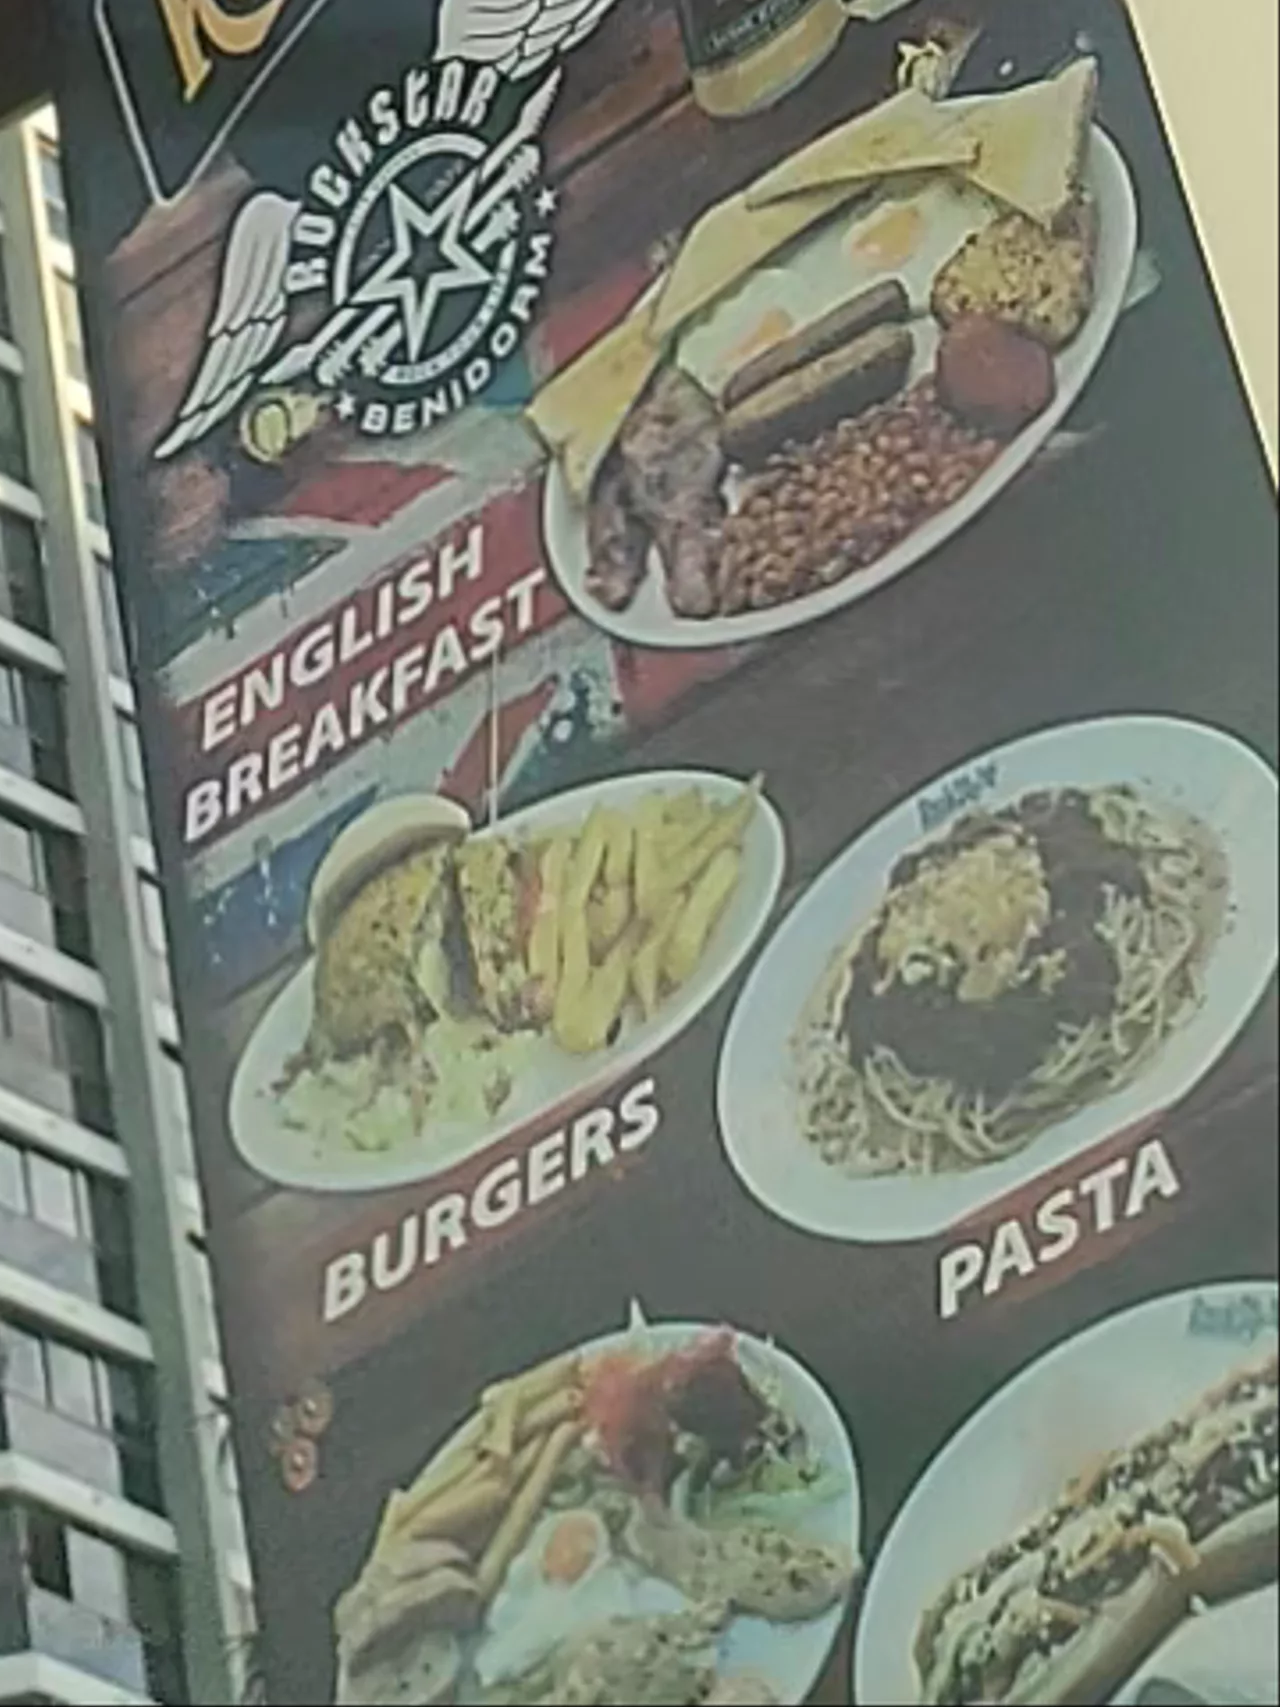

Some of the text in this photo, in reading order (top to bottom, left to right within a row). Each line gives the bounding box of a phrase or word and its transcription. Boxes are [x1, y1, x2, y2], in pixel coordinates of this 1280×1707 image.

[359, 232, 554, 434] BENIDORM
[181, 568, 548, 844] BREAKFAST
[197, 522, 487, 753] ENGLISH
[320, 1079, 664, 1326] BURGERS
[937, 1138, 1182, 1320] PASTA
